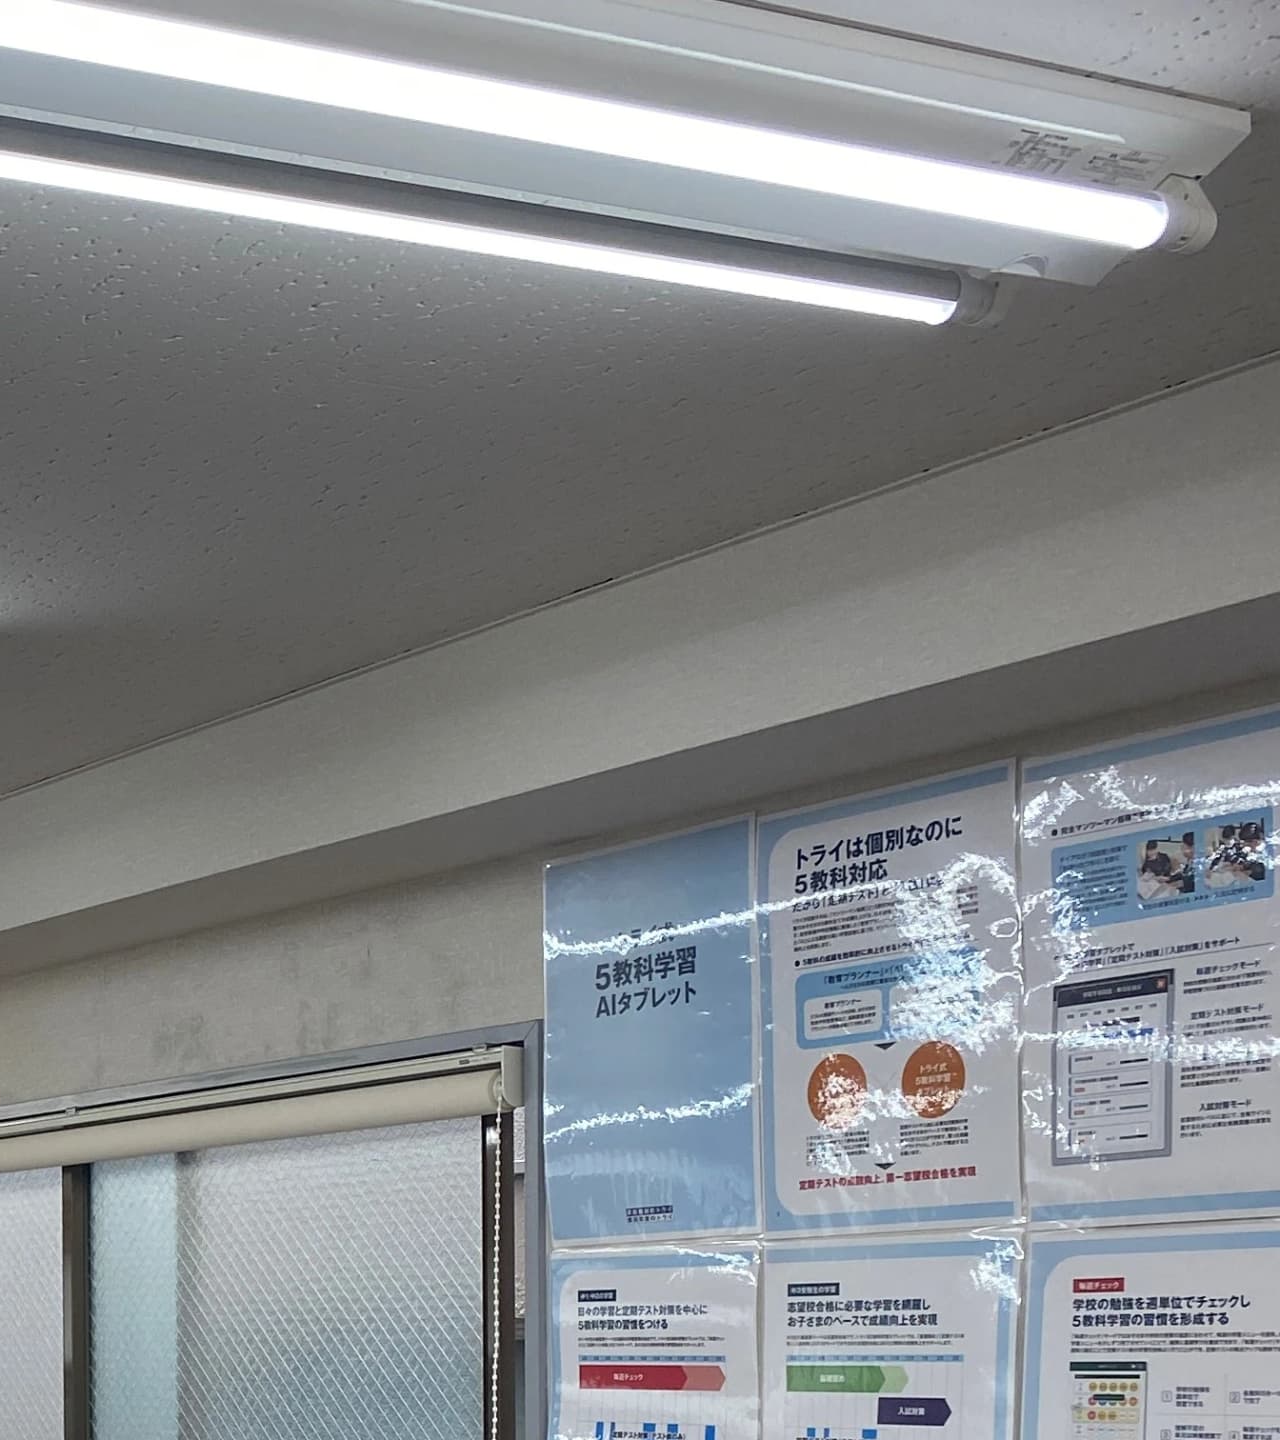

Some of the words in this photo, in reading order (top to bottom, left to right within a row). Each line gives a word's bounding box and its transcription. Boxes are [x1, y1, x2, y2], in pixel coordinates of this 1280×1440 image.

[796, 816, 963, 870] トライは個別なのに
[794, 858, 888, 895] 5教科対応
[595, 946, 697, 990] 5教科学習
[596, 981, 697, 1018] AIタブレット
[1072, 1294, 1251, 1312] 学校の勉強を週単位でチェックし
[1072, 1312, 1230, 1328] 5教科学習の習慣を形成する
